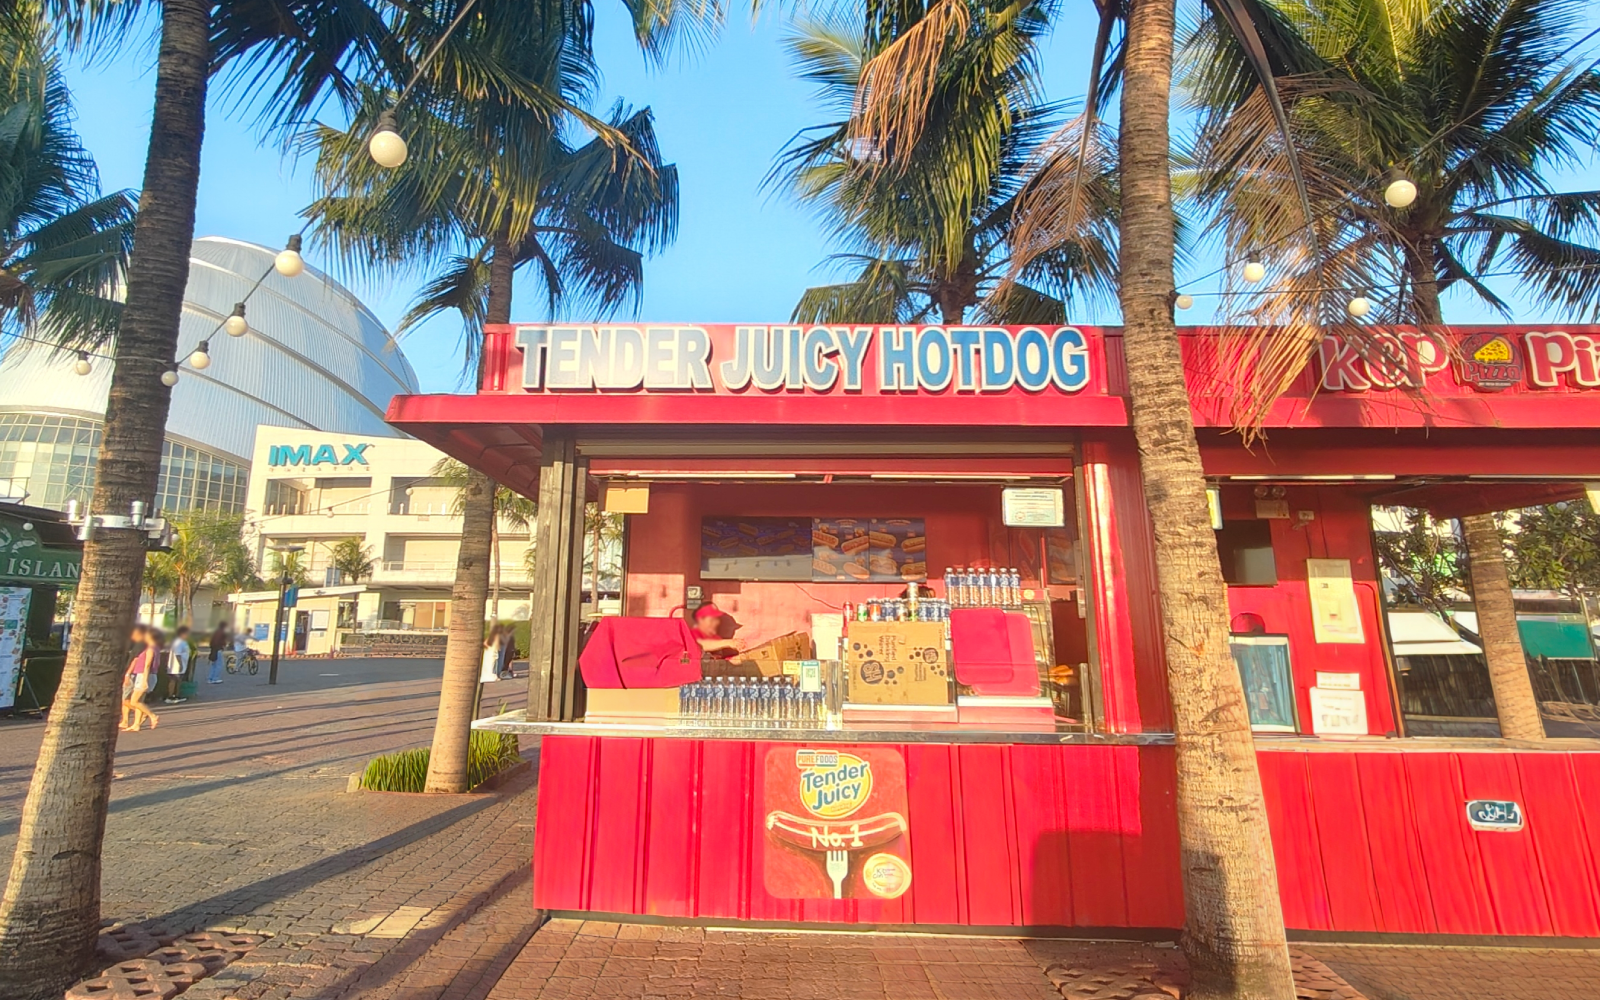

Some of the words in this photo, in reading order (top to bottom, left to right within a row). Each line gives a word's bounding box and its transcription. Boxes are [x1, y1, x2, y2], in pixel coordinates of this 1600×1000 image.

[516, 326, 713, 391] TENDER
[720, 326, 874, 391] JUICY
[879, 326, 1091, 393] HOTDOG
[1463, 361, 1521, 381] Pizza
[1521, 331, 1600, 388] Pi
[268, 443, 370, 467] IMAX
[6, 557, 82, 578] ISLAN
[797, 753, 839, 765] PUREFOODS
[801, 762, 868, 793] Tender
[811, 781, 862, 811] Juicy
[810, 825, 846, 849] No.
[849, 823, 864, 847] 1
